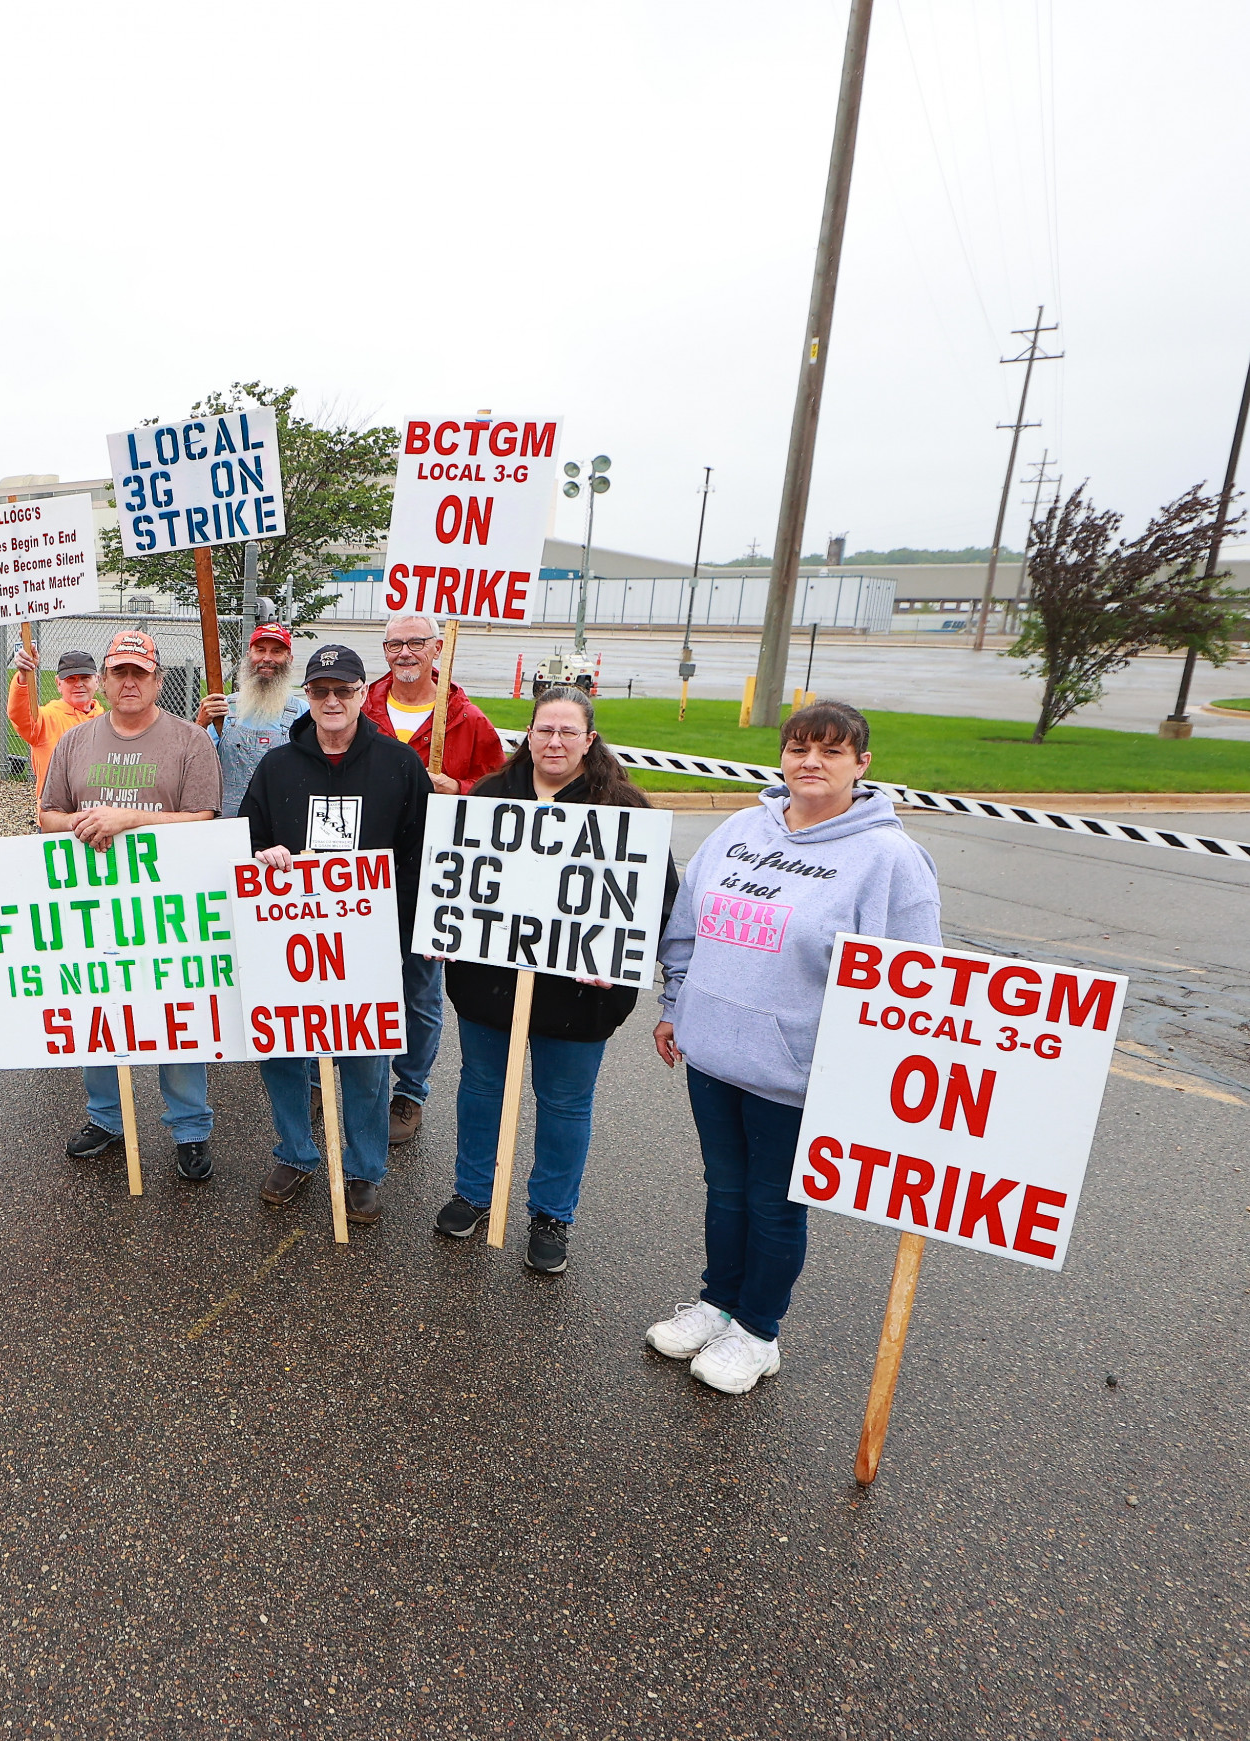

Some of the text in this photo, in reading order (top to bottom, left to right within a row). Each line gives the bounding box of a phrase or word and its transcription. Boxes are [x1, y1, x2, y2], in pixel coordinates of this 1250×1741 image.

[127, 414, 264, 470] LOCAL
[404, 421, 557, 457] BCTGM
[122, 455, 264, 512] 3G ON
[417, 463, 529, 482] LOCAL 3-G
[11, 535, 39, 552] Begin
[42, 533, 55, 546] To
[58, 529, 77, 544] End
[132, 496, 277, 550] STRIKE
[435, 494, 494, 545] ON
[13, 557, 52, 573] Become
[56, 551, 84, 567] Silent
[23, 579, 45, 593] That
[48, 572, 85, 589] Matter"
[0, 605, 12, 618] M.
[15, 603, 24, 615] L.
[27, 599, 49, 615] King
[53, 597, 65, 610] Jr.
[385, 563, 531, 620] STRIKE
[88, 764, 156, 787] ARGUING
[107, 752, 142, 765] I'M NOT
[100, 787, 139, 802] I'M JUST
[452, 799, 648, 864] LOCAL
[42, 832, 161, 890] OUR
[234, 855, 391, 898] BCTGM
[725, 842, 838, 880] Our future
[431, 851, 638, 922] 3G ON
[719, 872, 782, 900] is not
[255, 898, 372, 922] LOCAL 3-G
[700, 914, 778, 948] SALE
[710, 896, 777, 926] FOR
[285, 931, 346, 983] ON
[431, 905, 647, 982] STRIKE
[7, 954, 235, 998] IS NOT FOR
[836, 940, 1118, 1032] BCTGM
[42, 994, 224, 1060] SALE!
[250, 1001, 403, 1054] STRIKE
[858, 1001, 1063, 1060] LOCAL 3-G
[889, 1054, 998, 1139] ON
[802, 1135, 1069, 1261] STRIKE
